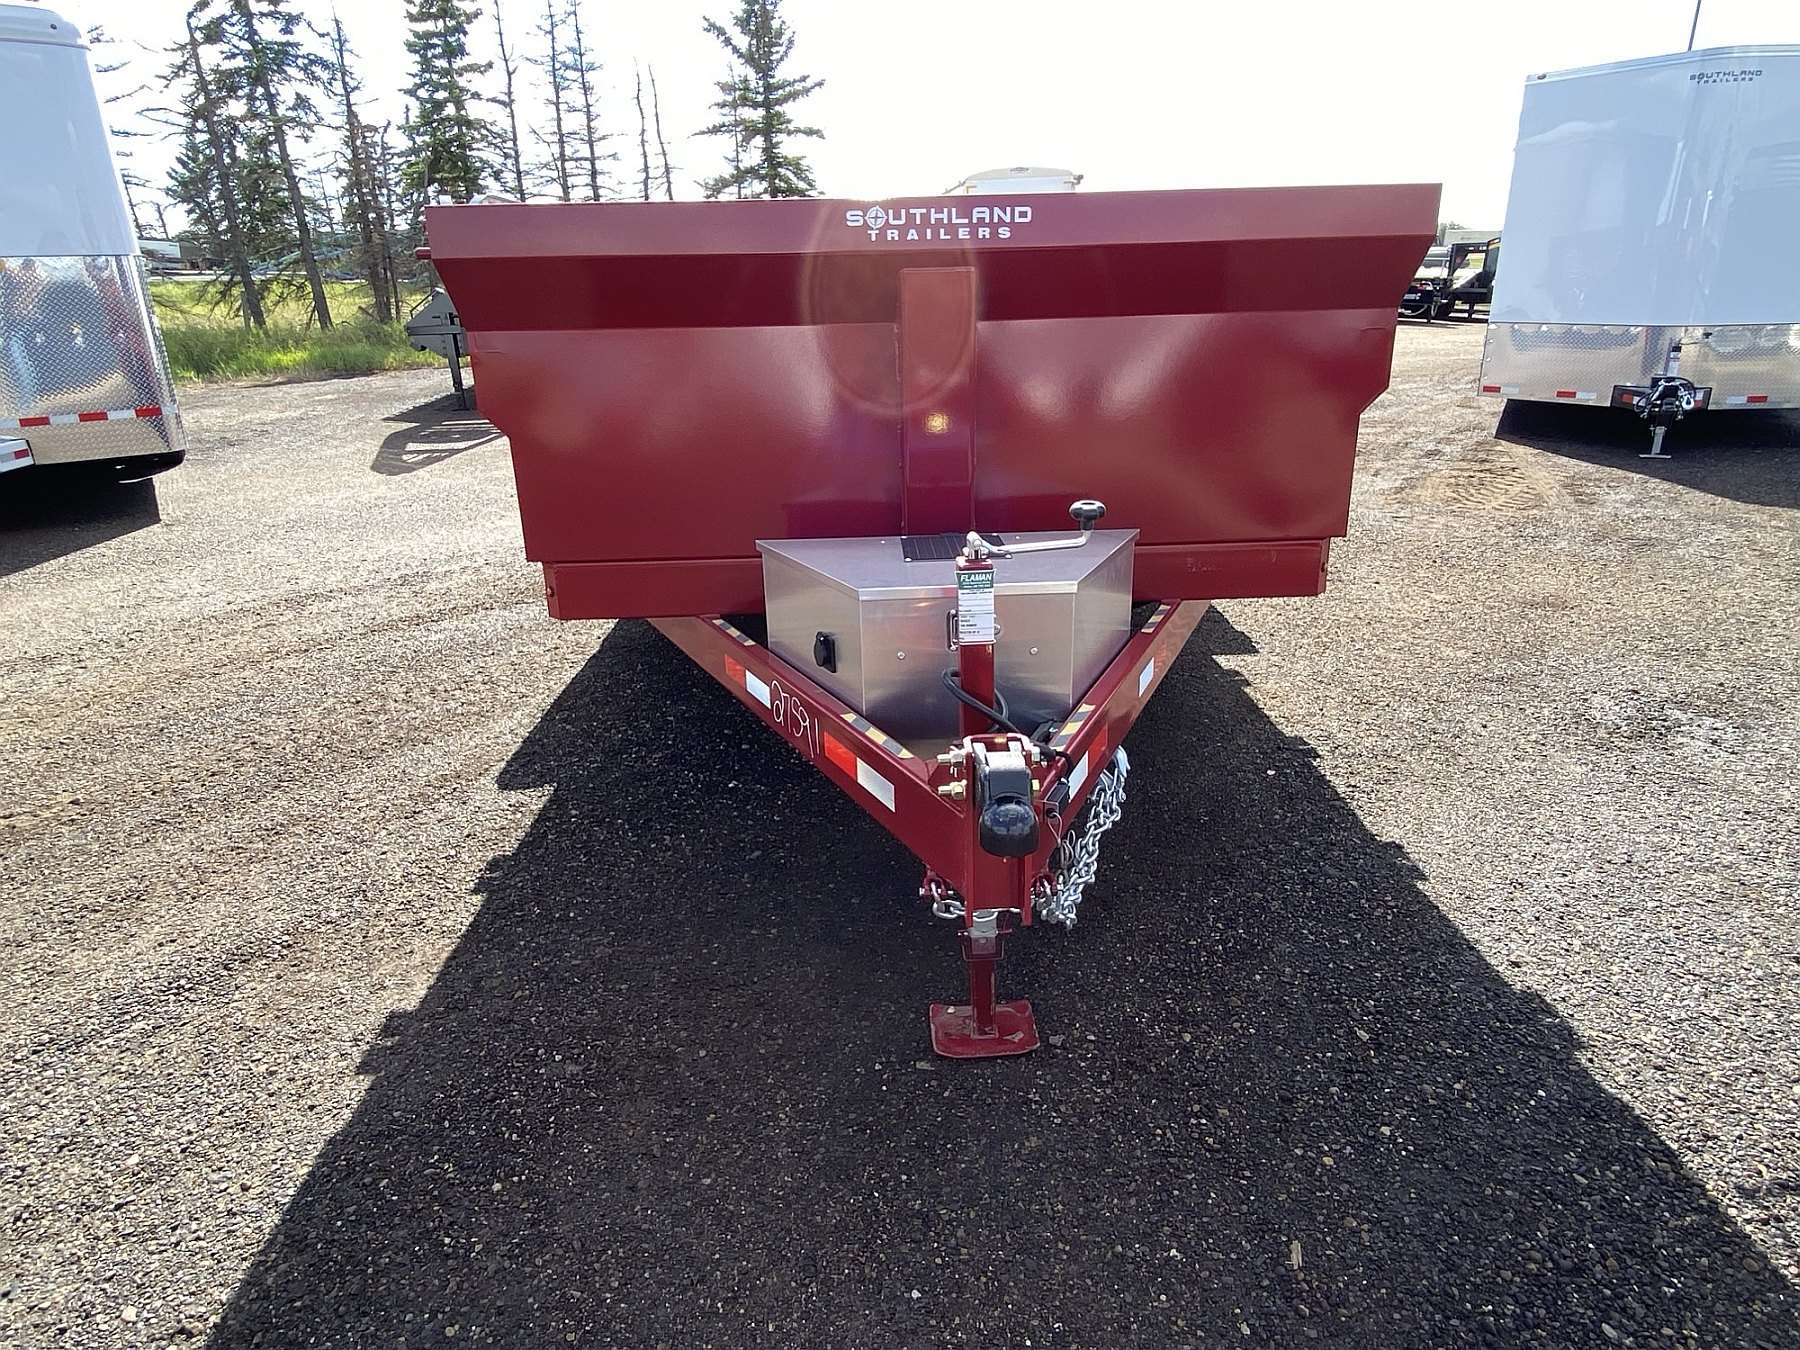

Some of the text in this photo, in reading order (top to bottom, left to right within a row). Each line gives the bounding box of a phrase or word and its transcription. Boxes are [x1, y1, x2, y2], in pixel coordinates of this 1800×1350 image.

[1689, 70, 1763, 81] SOUTHLAND
[845, 205, 1032, 228] SOUTHLAND
[867, 227, 1011, 242] TRAILERS
[960, 573, 992, 582] FLAMAN
